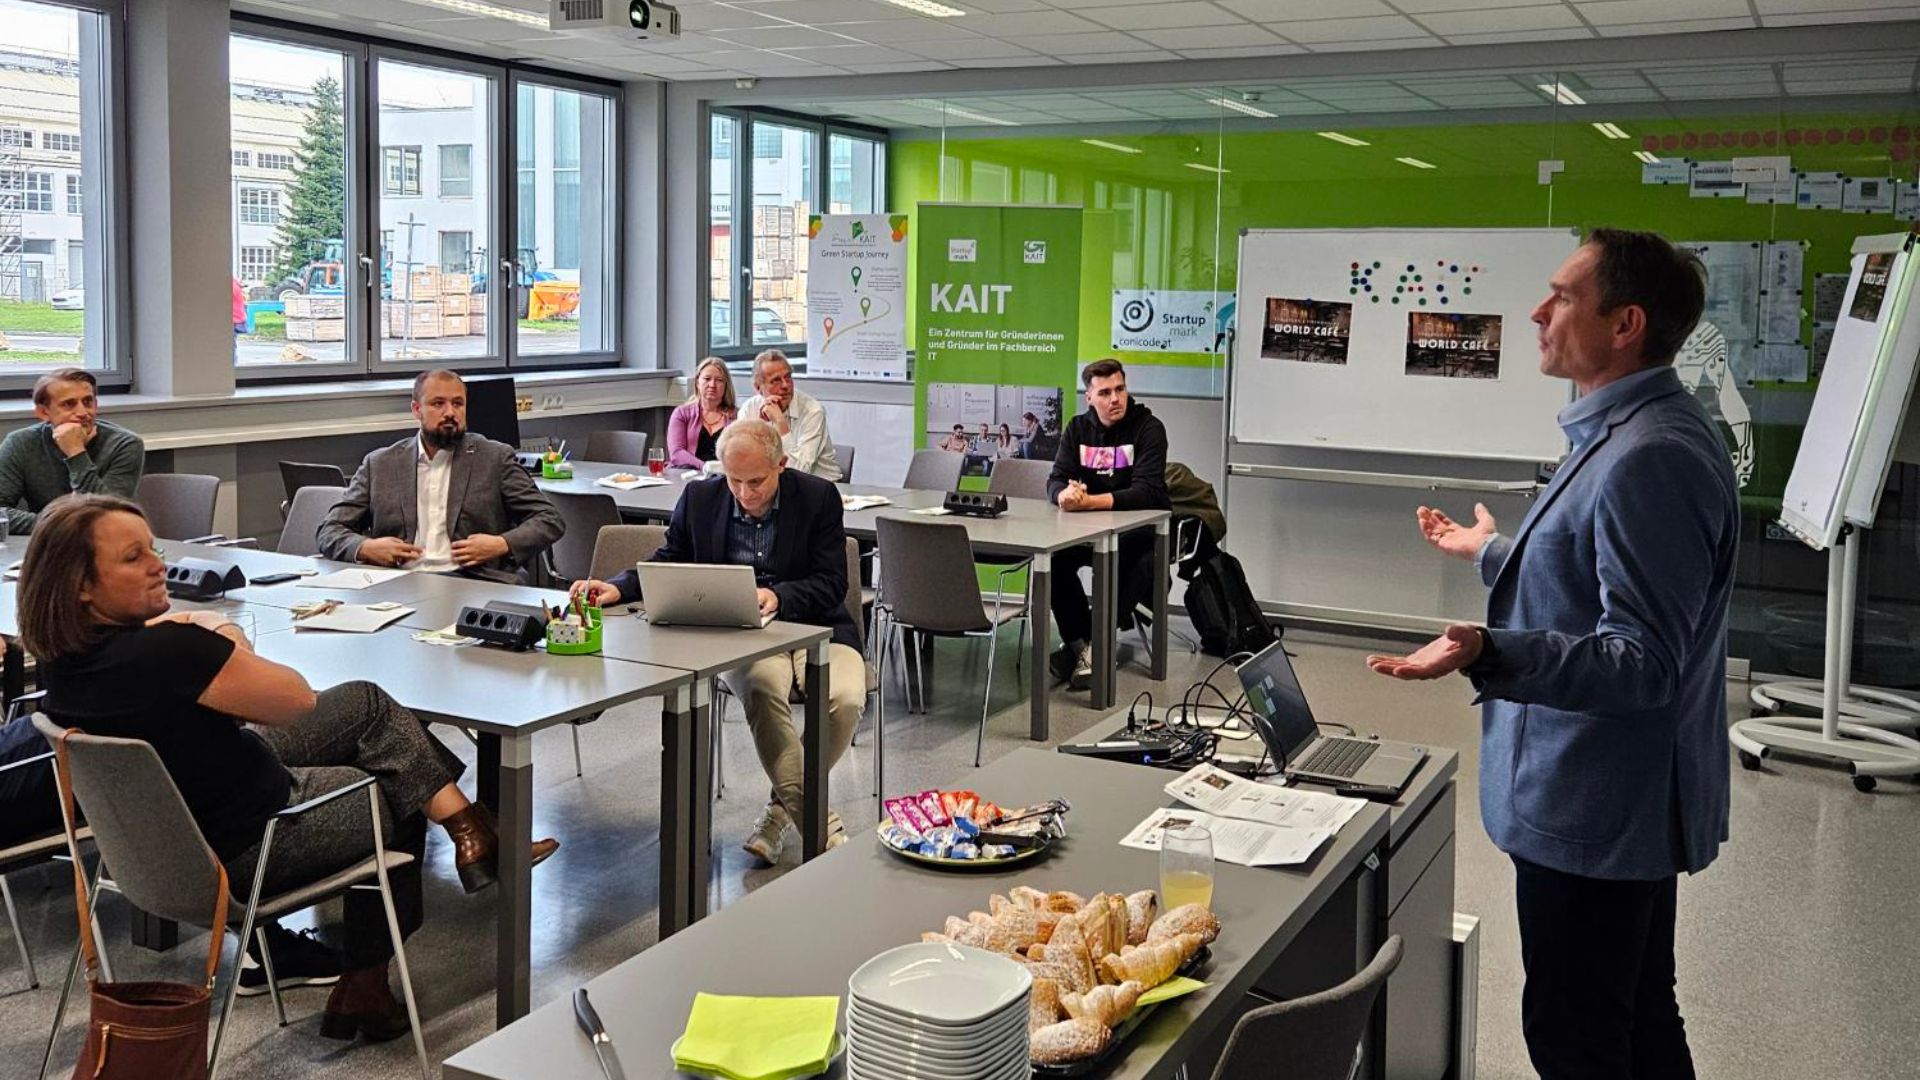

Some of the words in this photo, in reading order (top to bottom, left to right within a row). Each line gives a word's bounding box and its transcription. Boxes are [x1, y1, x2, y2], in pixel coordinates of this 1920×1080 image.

[821, 249, 840, 257] Green
[841, 249, 865, 259] Startup
[865, 250, 889, 260] Journey
[930, 283, 1012, 315] KAIT
[1162, 313, 1206, 326] Startup
[928, 328, 943, 337] Ein
[944, 328, 984, 338] Zentrum
[985, 330, 999, 339] für
[1000, 330, 1065, 341] Gründerinnen
[1169, 326, 1198, 337] mark
[1274, 323, 1311, 335] WORLD
[928, 341, 945, 350] und
[946, 341, 985, 351] Gründer
[986, 342, 998, 351] im
[1000, 342, 1057, 353] Fachbereich
[1418, 338, 1458, 350] WORLD
[927, 352, 938, 361] IT
